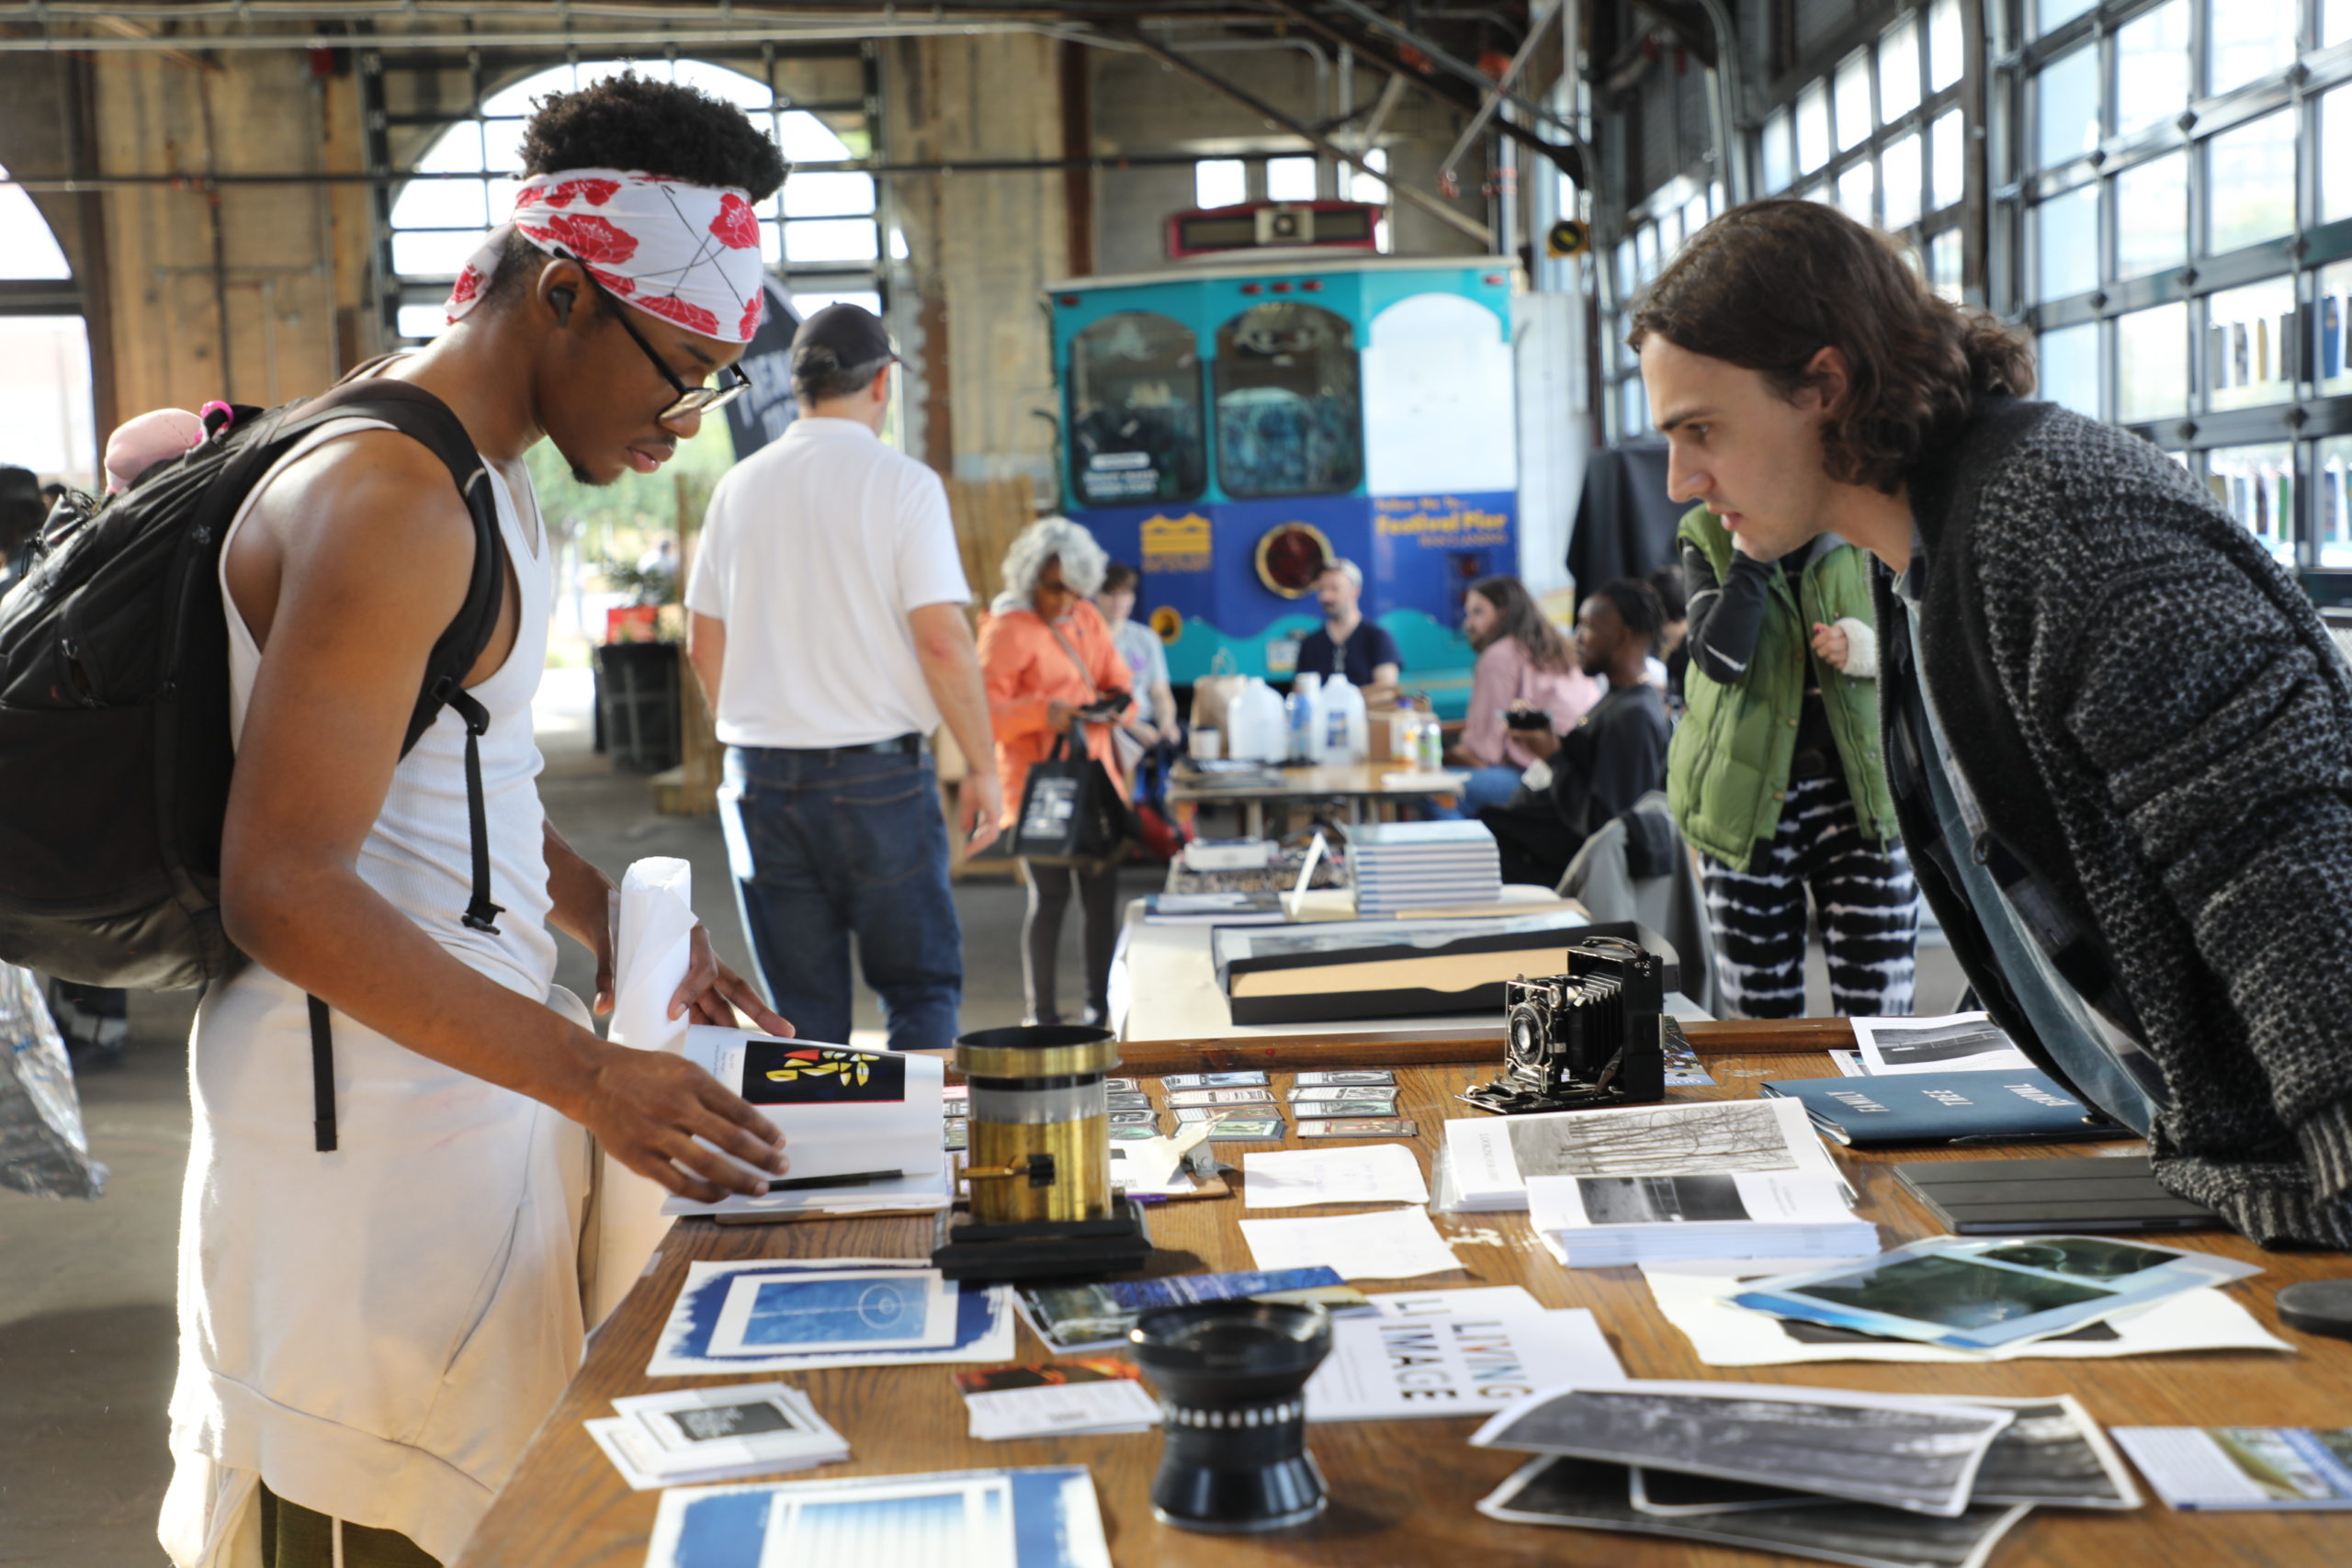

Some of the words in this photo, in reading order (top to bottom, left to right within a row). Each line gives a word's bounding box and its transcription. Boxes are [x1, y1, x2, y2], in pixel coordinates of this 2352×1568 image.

[1824, 1090, 1891, 1112] FAMILY
[1920, 1089, 1974, 1106] TREE
[1379, 1324, 1458, 1400] IMAGE
[1452, 1321, 1534, 1399] LIVING
